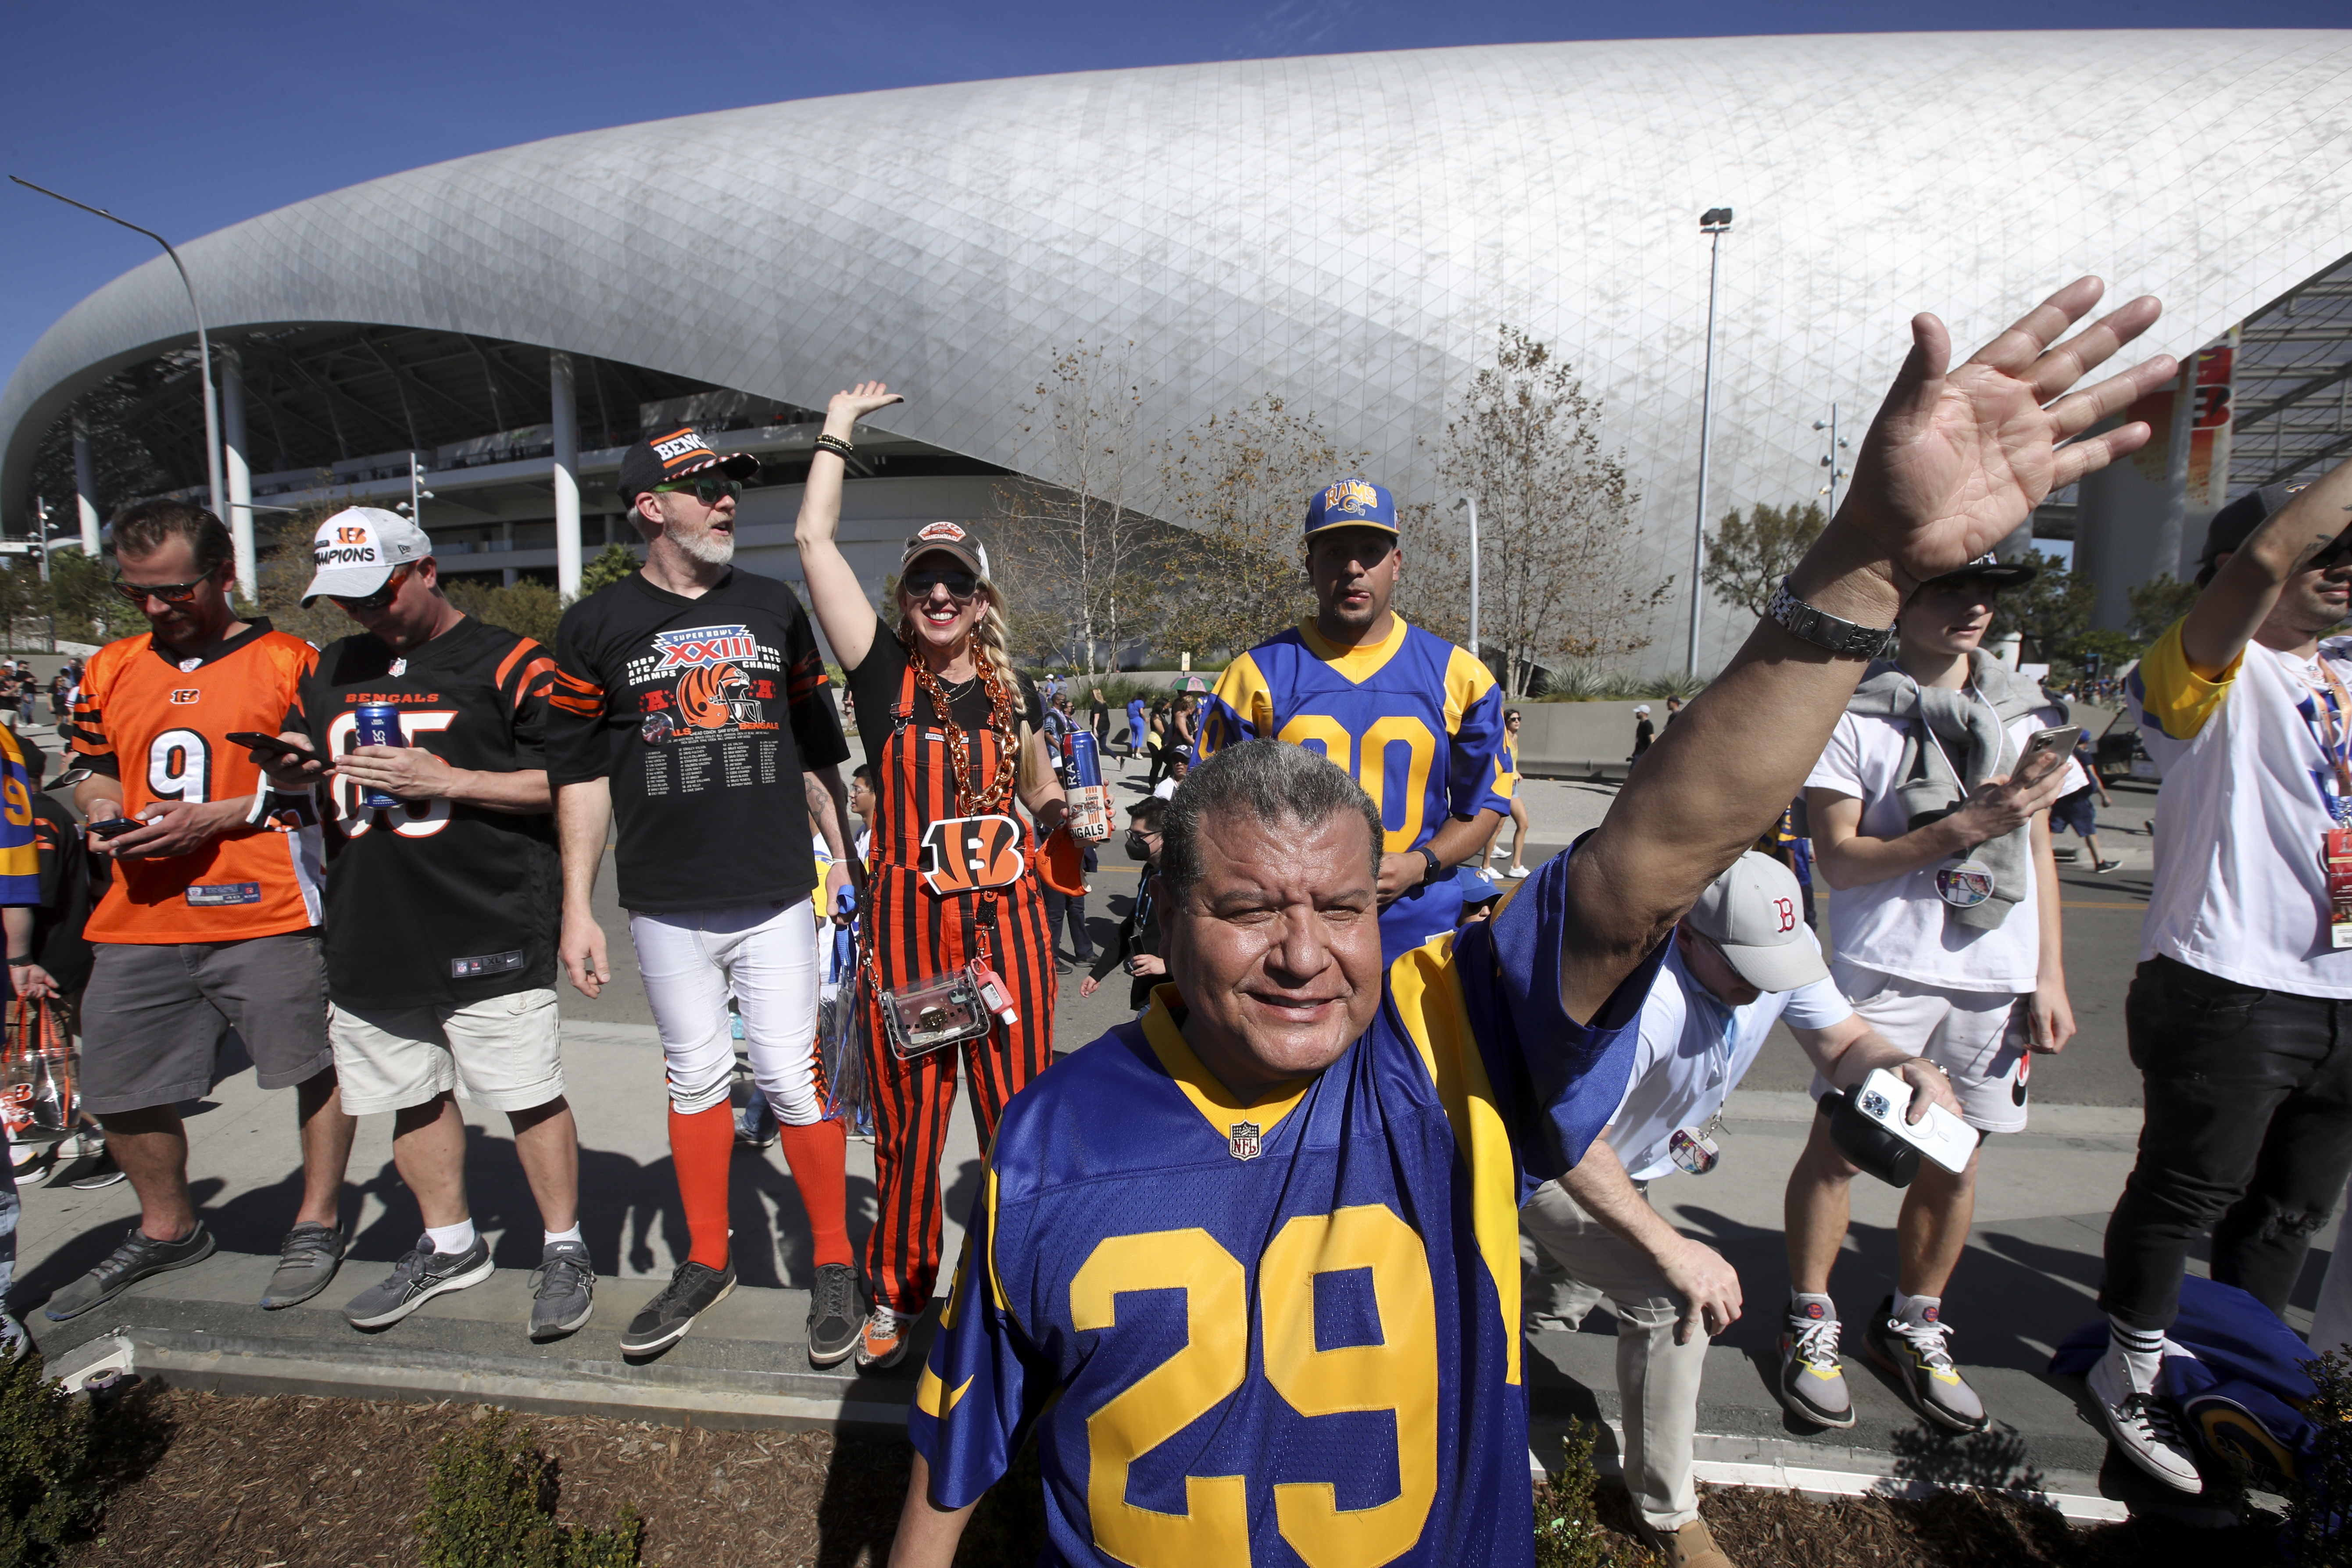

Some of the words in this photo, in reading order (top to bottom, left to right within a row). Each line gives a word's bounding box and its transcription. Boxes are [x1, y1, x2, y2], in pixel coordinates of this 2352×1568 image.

[653, 434, 710, 461] BENG
[1325, 482, 1377, 512] RAMS
[673, 632, 704, 642] SUPER
[662, 637, 754, 666] XXIII
[757, 645, 779, 656] 1988
[626, 656, 655, 669] 1988
[629, 665, 650, 677] AFC
[742, 661, 780, 671] CHAMPS
[629, 670, 676, 686] CHAMPS
[345, 693, 439, 703] BENGALS
[147, 727, 212, 826] 9
[1772, 896, 1796, 933] B
[1233, 1138, 1256, 1156] NFL
[1069, 1203, 1439, 1568] 29
